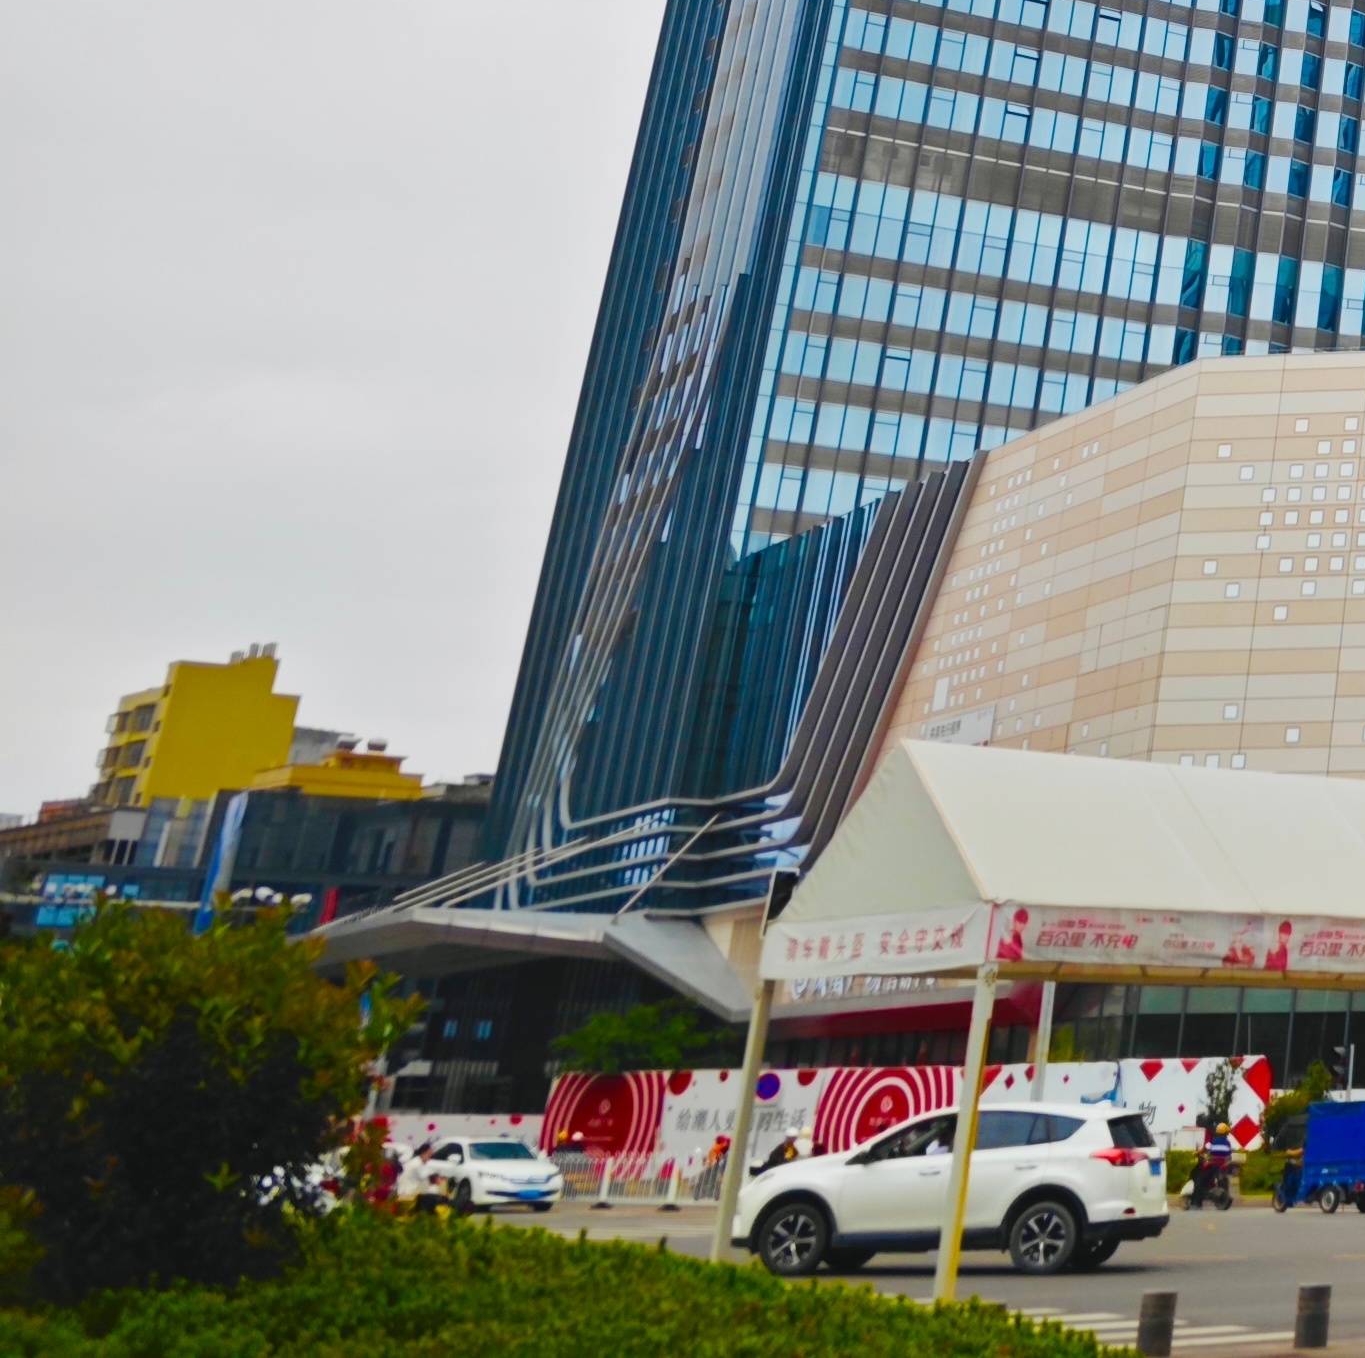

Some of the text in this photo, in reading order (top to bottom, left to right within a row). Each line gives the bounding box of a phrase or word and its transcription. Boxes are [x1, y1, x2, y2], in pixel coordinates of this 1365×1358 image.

[1035, 931, 1139, 950] 百公里 不充电
[1299, 941, 1343, 958] 百公里
[675, 1107, 807, 1132] 给潮人更的生活
